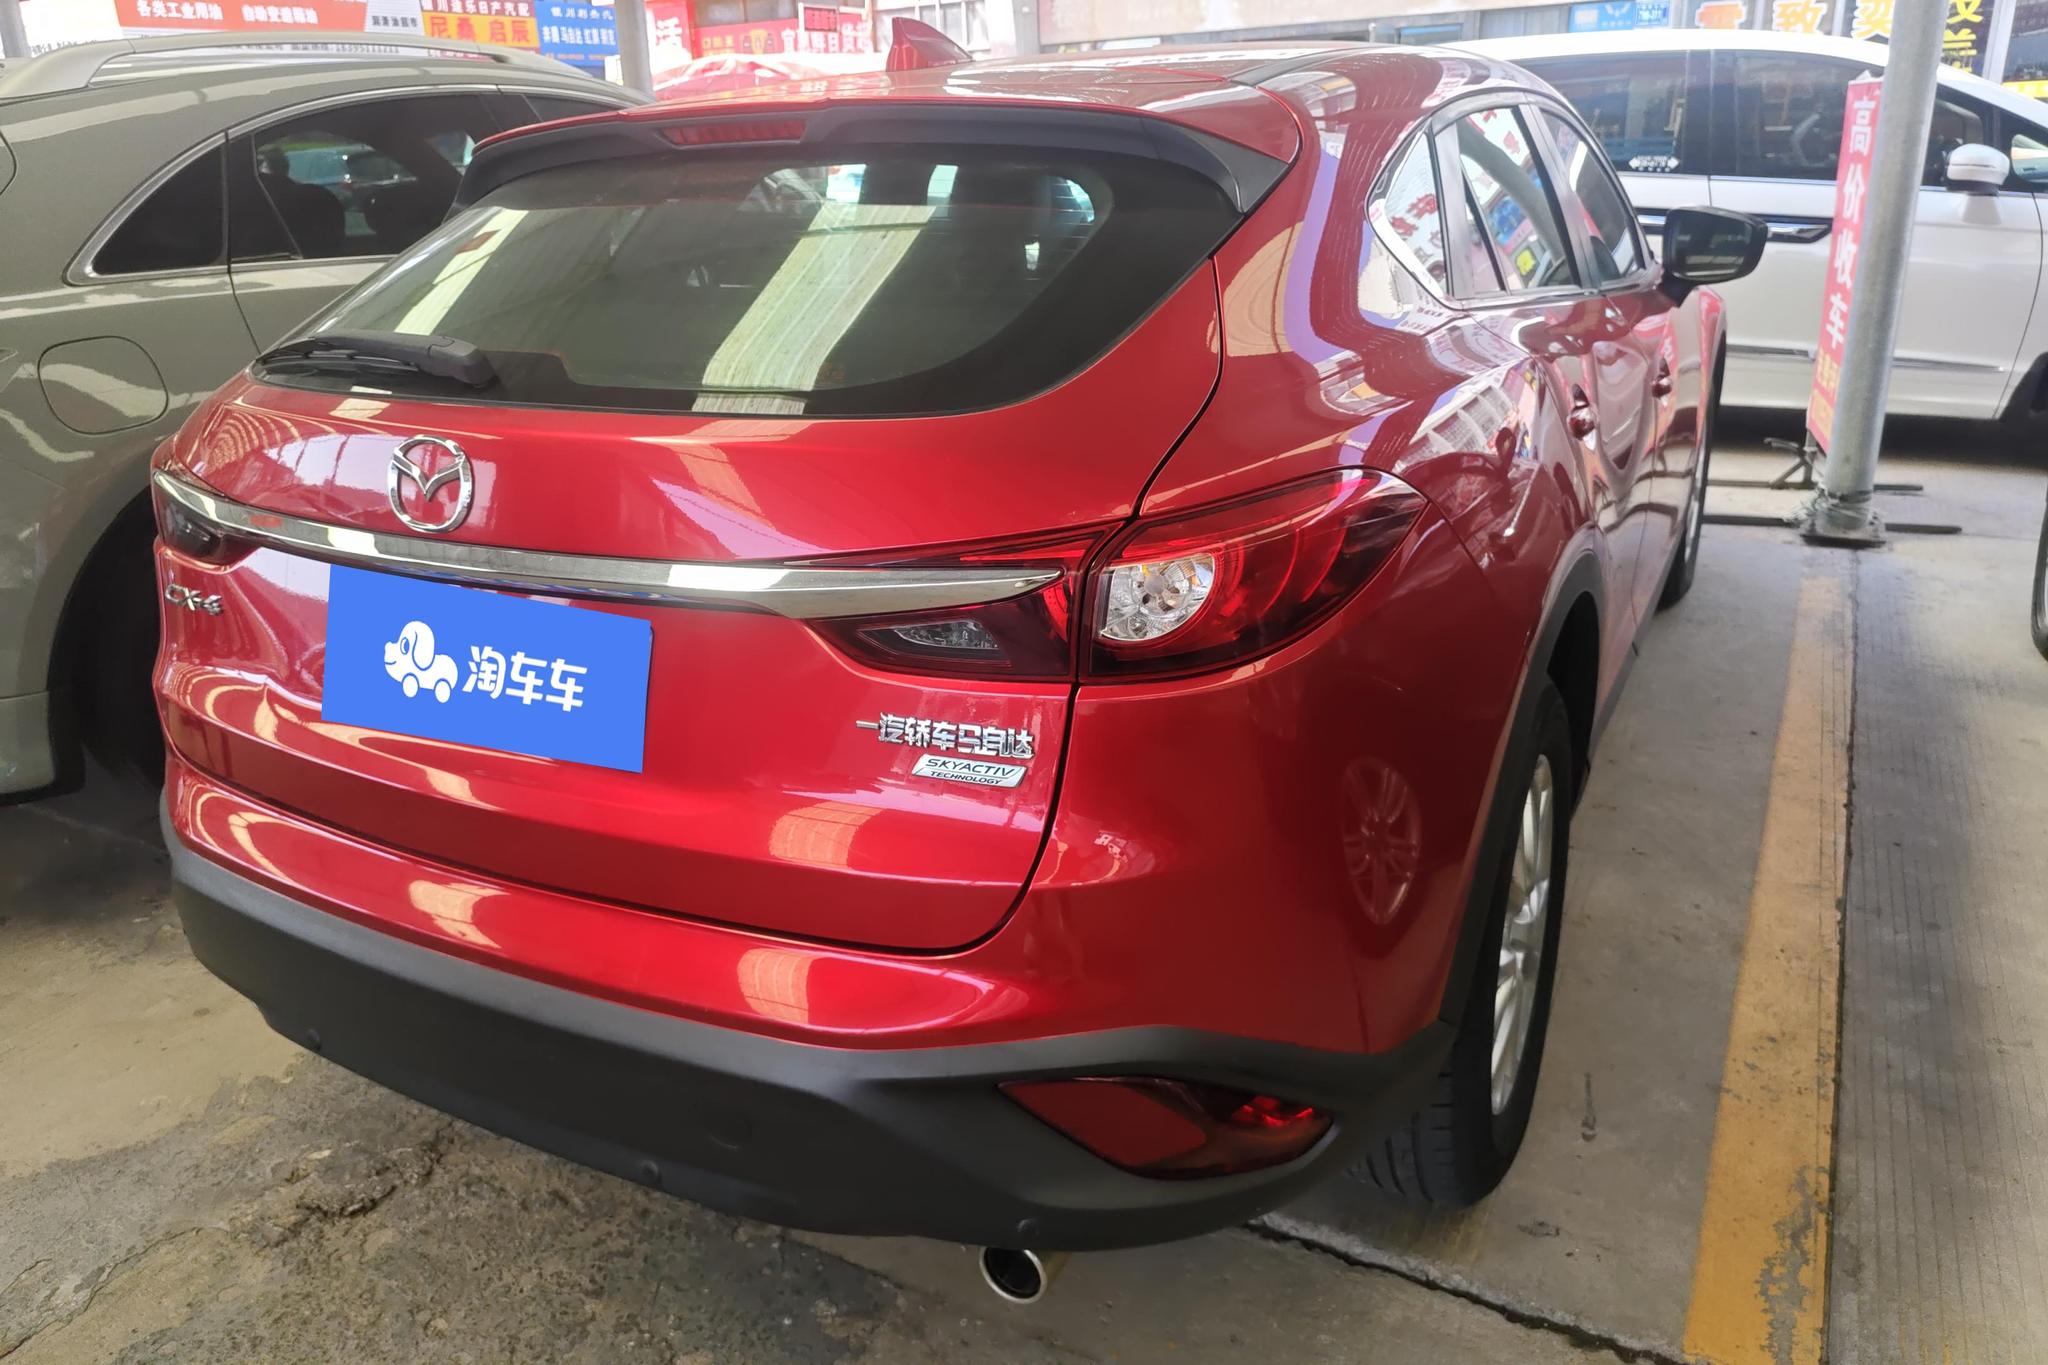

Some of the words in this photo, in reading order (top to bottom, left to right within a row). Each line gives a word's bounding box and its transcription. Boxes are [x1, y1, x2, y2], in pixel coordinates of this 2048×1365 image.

[1825, 97, 1876, 349] 高价收车
[856, 712, 1035, 759] 一汽轿车马自达
[926, 758, 1015, 777] SKYACTIV
[931, 771, 1002, 785] TECHNOLOGY
